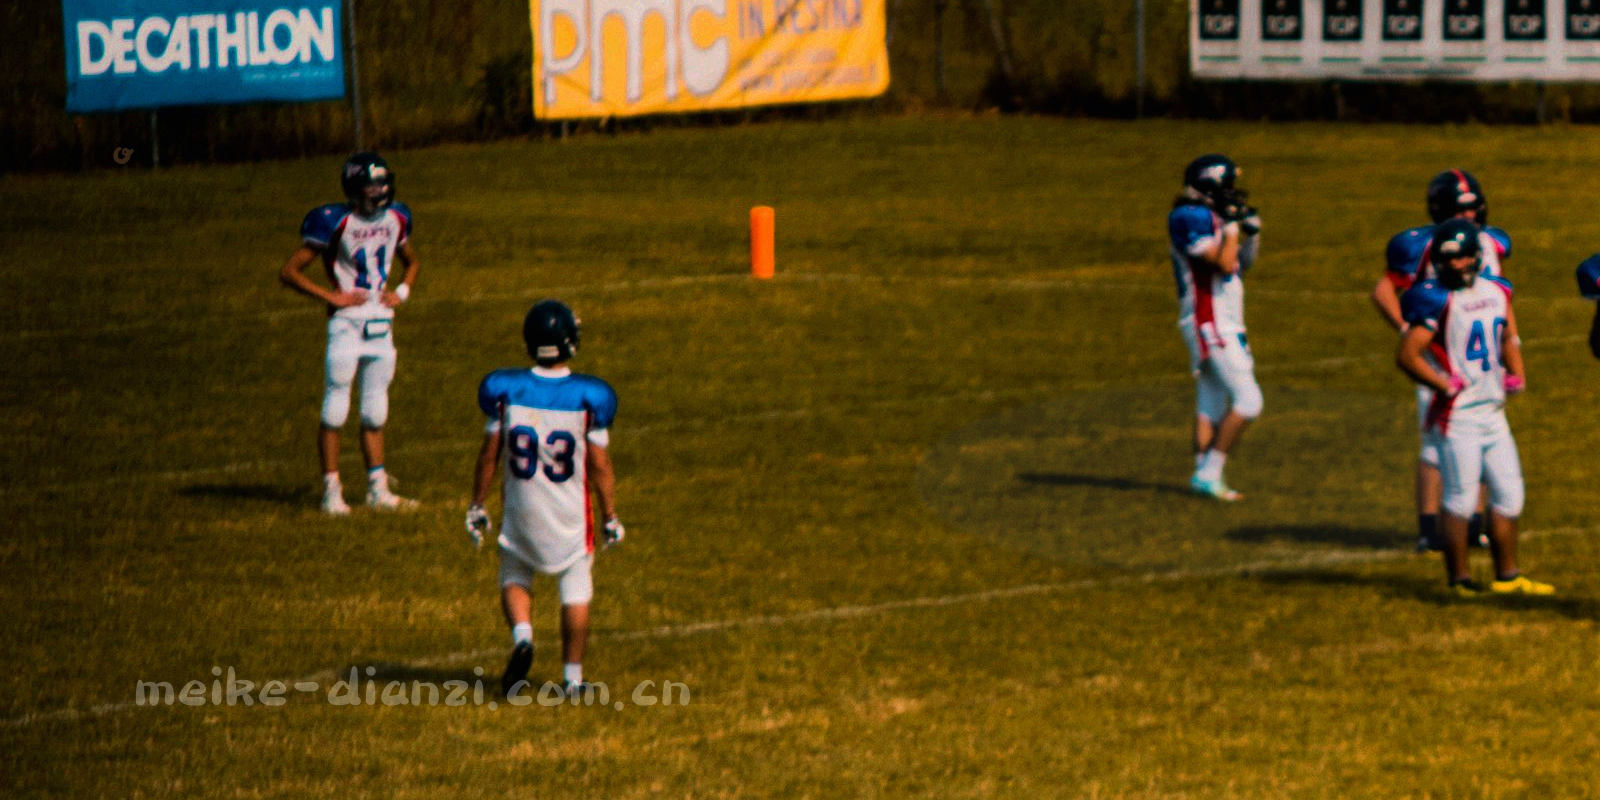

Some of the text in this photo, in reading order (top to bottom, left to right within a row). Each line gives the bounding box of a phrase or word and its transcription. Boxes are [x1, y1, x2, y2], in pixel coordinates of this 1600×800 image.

[77, 7, 334, 76] DECATHLON
[354, 245, 388, 291] 11
[509, 424, 576, 482] 93
